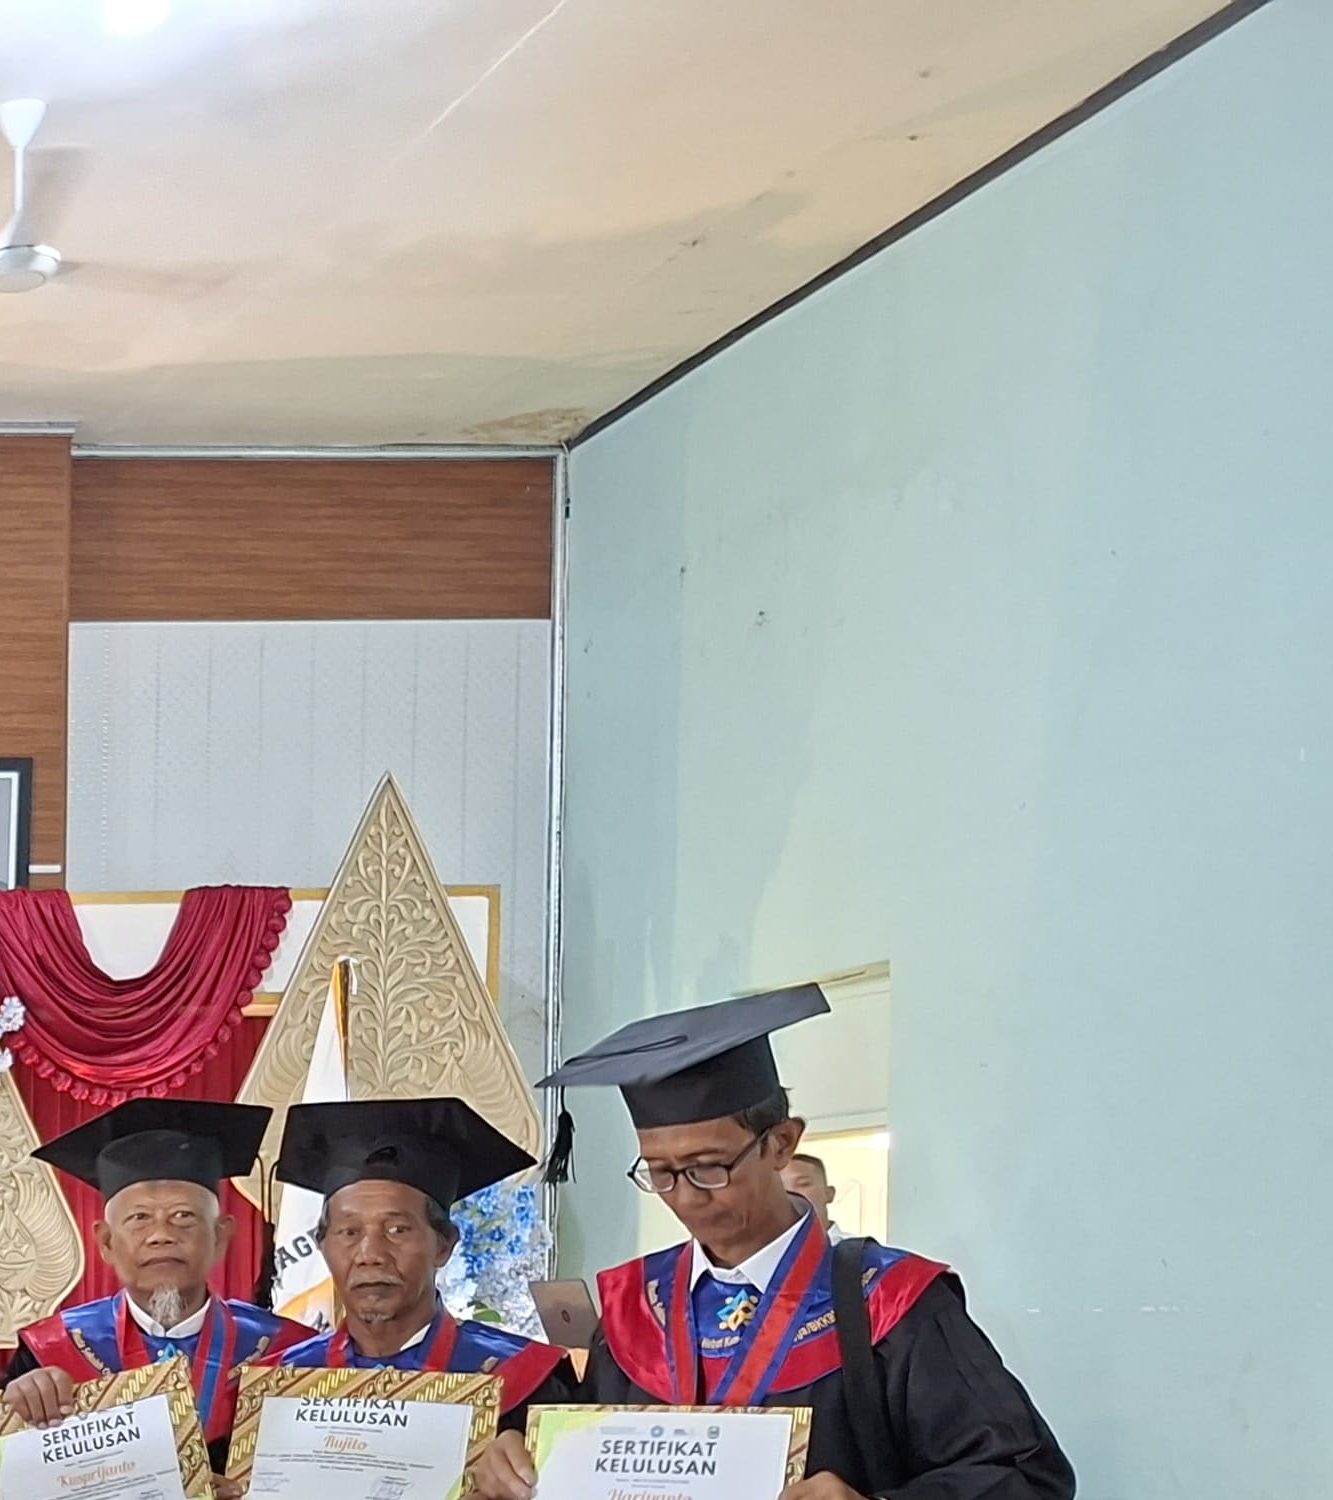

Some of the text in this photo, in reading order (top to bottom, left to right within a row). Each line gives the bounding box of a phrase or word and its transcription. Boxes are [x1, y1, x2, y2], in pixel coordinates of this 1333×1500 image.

[295, 1409, 408, 1427] KELULUSAN
[42, 1412, 134, 1447] SERTIFIKAT
[43, 1427, 141, 1464] KELULUSAN
[600, 1440, 718, 1457] SERTIFIKAT
[595, 1458, 716, 1476] KELULUSAN
